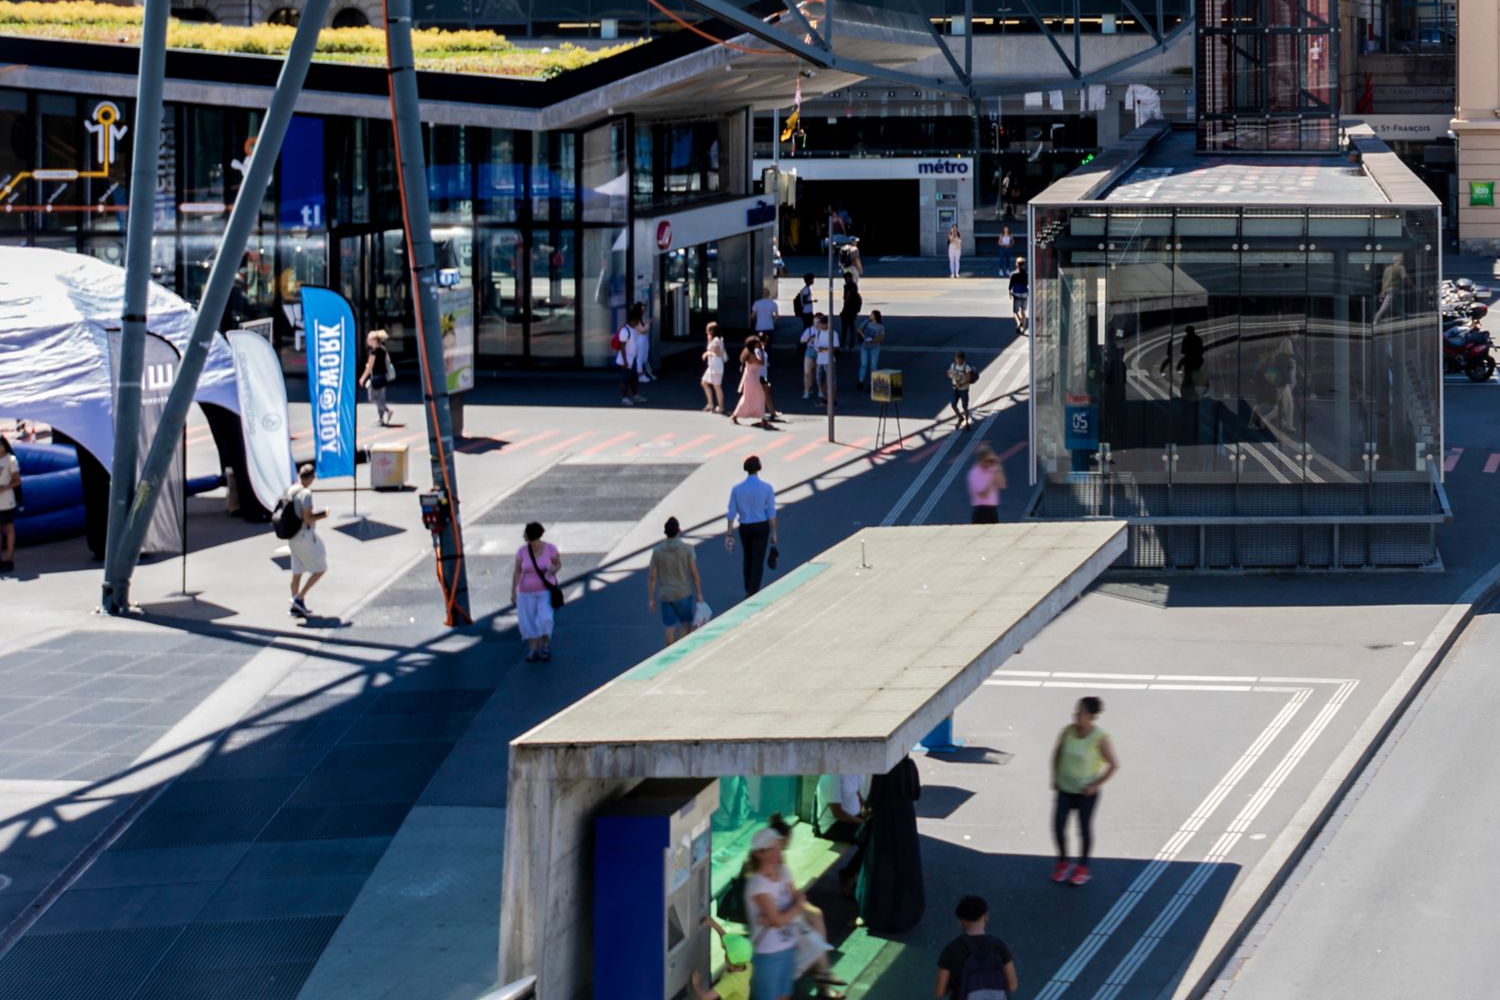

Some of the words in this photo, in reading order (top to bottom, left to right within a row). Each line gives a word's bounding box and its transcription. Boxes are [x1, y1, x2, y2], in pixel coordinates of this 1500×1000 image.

[918, 158, 968, 174] métro
[300, 204, 321, 226] tl
[1072, 413, 1089, 429] 05
